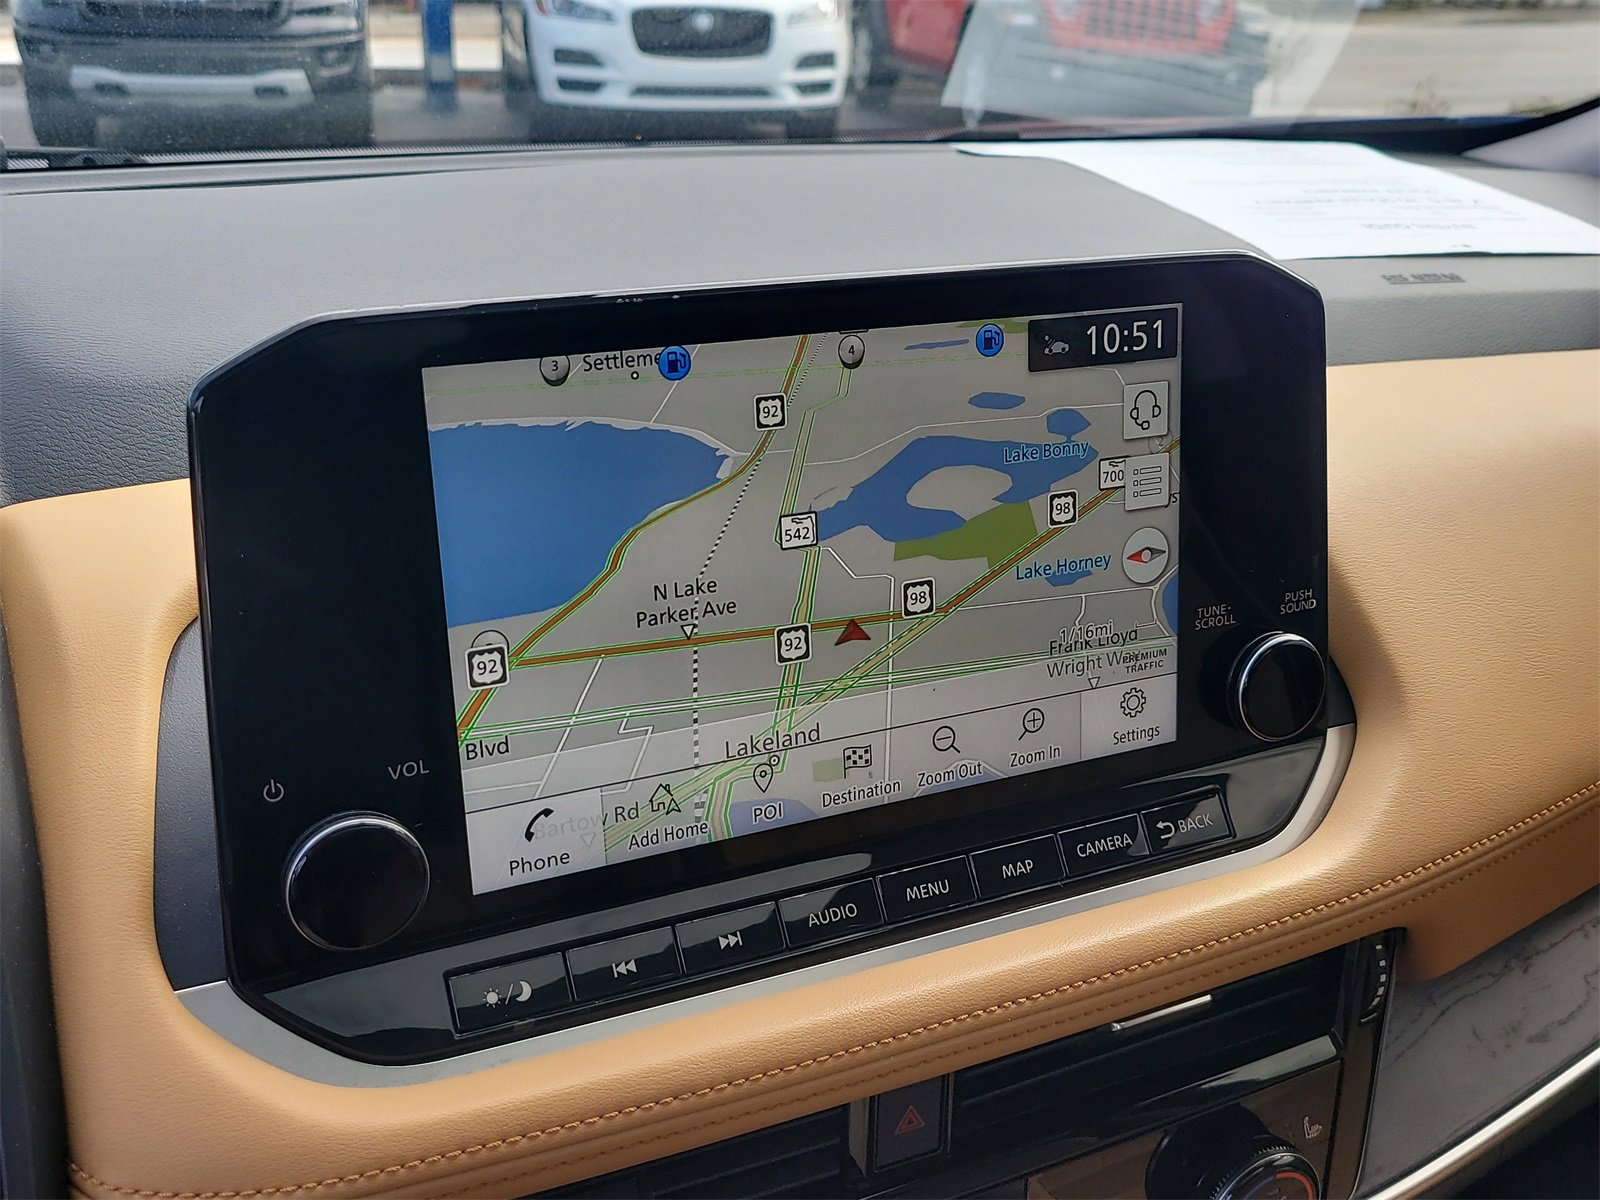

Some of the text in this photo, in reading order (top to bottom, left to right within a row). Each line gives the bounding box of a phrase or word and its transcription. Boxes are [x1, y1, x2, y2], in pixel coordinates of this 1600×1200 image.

[1086, 319, 1166, 355] 10:51
[848, 344, 856, 357] 4
[551, 360, 559, 372] 3
[762, 404, 780, 420] 92
[1003, 441, 1089, 464] Lake Bonny
[1102, 466, 1125, 484] 700
[1055, 499, 1072, 516] 98
[785, 526, 812, 543] 542
[1016, 553, 1112, 581] Lake Horney
[653, 578, 718, 601] N Lake
[910, 589, 928, 606] 98
[1285, 588, 1313, 602] PUSH
[636, 599, 737, 628] Parker Ave
[1280, 599, 1317, 615] SOUND
[1060, 620, 1113, 643] 1/16mi
[1195, 614, 1236, 630] SCROLL
[783, 637, 802, 653] 92
[476, 658, 499, 677] 92
[1047, 655, 1103, 678] Wright
[1122, 648, 1168, 665] PREMIUM
[1125, 659, 1164, 675] TRAFFIC
[725, 722, 821, 759] Lakeland
[1112, 724, 1161, 746] Settings
[465, 736, 509, 760] Blvd
[1010, 745, 1062, 768] Zoom In
[388, 760, 430, 780] VOL
[918, 761, 983, 788] Zoom Out
[822, 780, 901, 808] Destination
[614, 801, 640, 824] Rd
[753, 802, 784, 824] POI
[1178, 812, 1214, 833] BACK
[628, 821, 709, 851] Add Home
[1076, 831, 1134, 858] CAMERA
[509, 852, 571, 877] Phone
[1001, 858, 1034, 878] MAP
[905, 878, 951, 902] MENU
[807, 902, 859, 928] AUDIO
